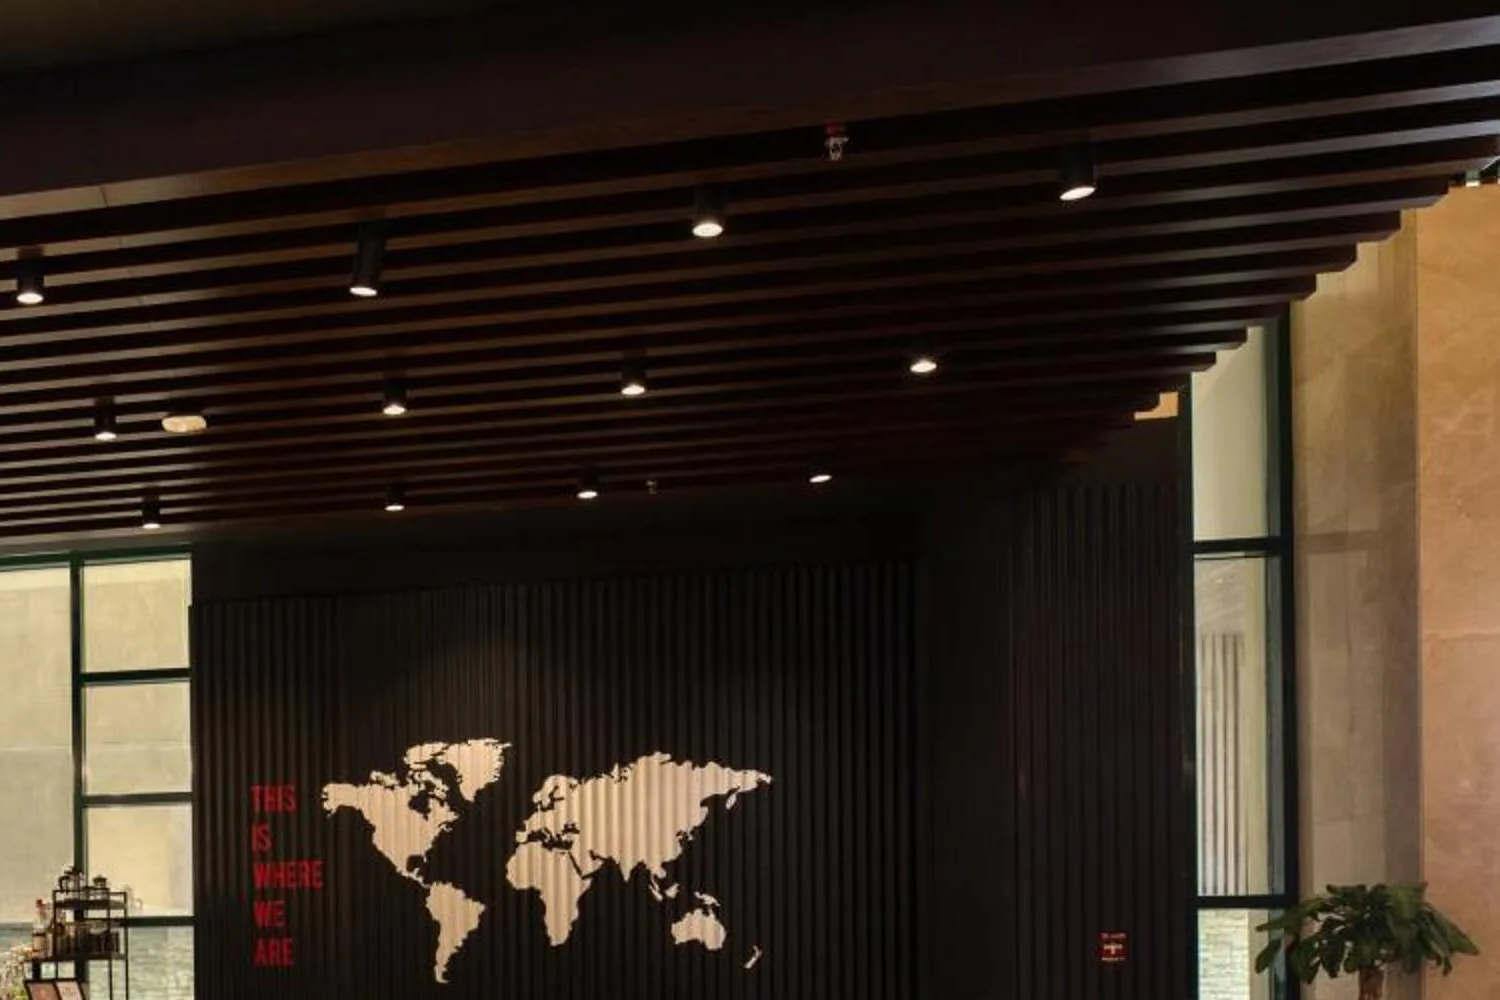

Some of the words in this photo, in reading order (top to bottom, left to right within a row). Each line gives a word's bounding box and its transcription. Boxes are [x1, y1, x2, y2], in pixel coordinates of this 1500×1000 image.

[250, 784, 297, 814] THIS
[252, 822, 272, 852] IS
[254, 859, 324, 889] WHERE
[255, 900, 286, 928] WE
[255, 937, 293, 967] ARE
